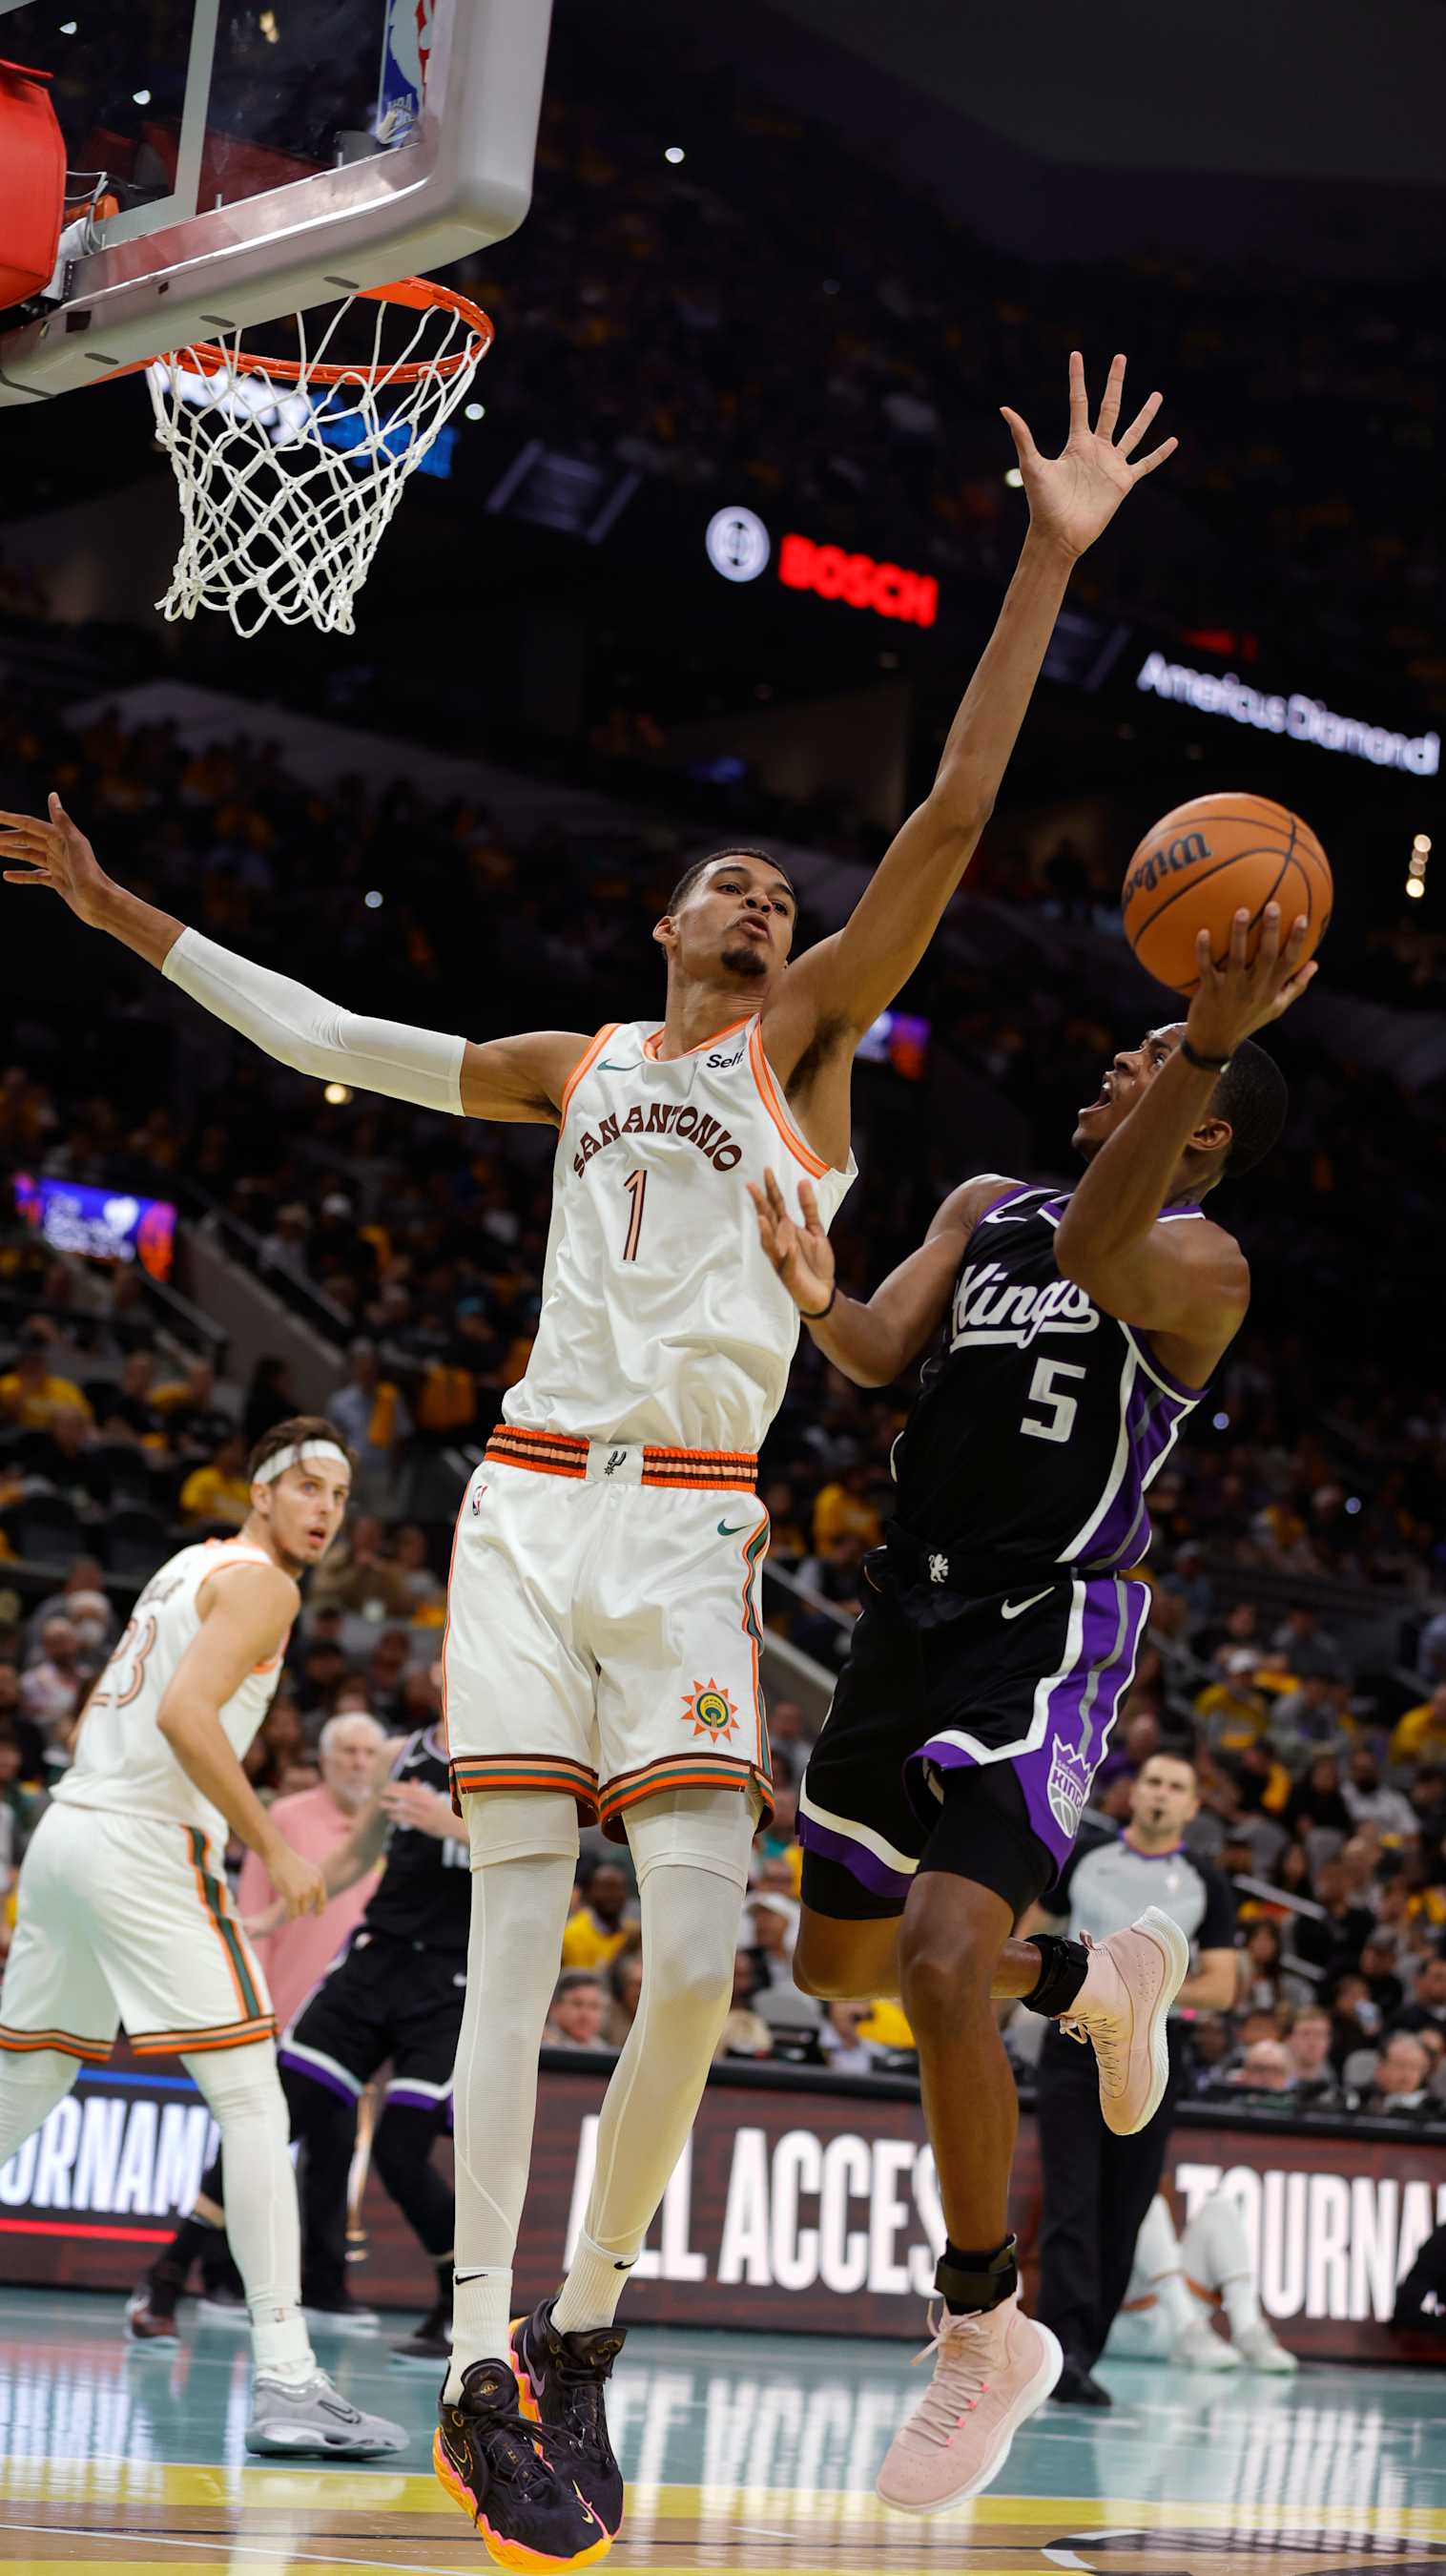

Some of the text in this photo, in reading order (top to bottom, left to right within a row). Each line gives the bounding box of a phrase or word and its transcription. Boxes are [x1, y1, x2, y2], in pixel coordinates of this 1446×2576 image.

[779, 533, 939, 628] BOSCH
[1137, 651, 1440, 776] Americus Diamond
[573, 1103, 742, 1179] SAN ANTONIO
[624, 1169, 647, 1261] 1
[950, 1262, 1100, 1351] Kings
[1020, 1357, 1086, 1443] 5
[717, 2128, 950, 2299] ACCES
